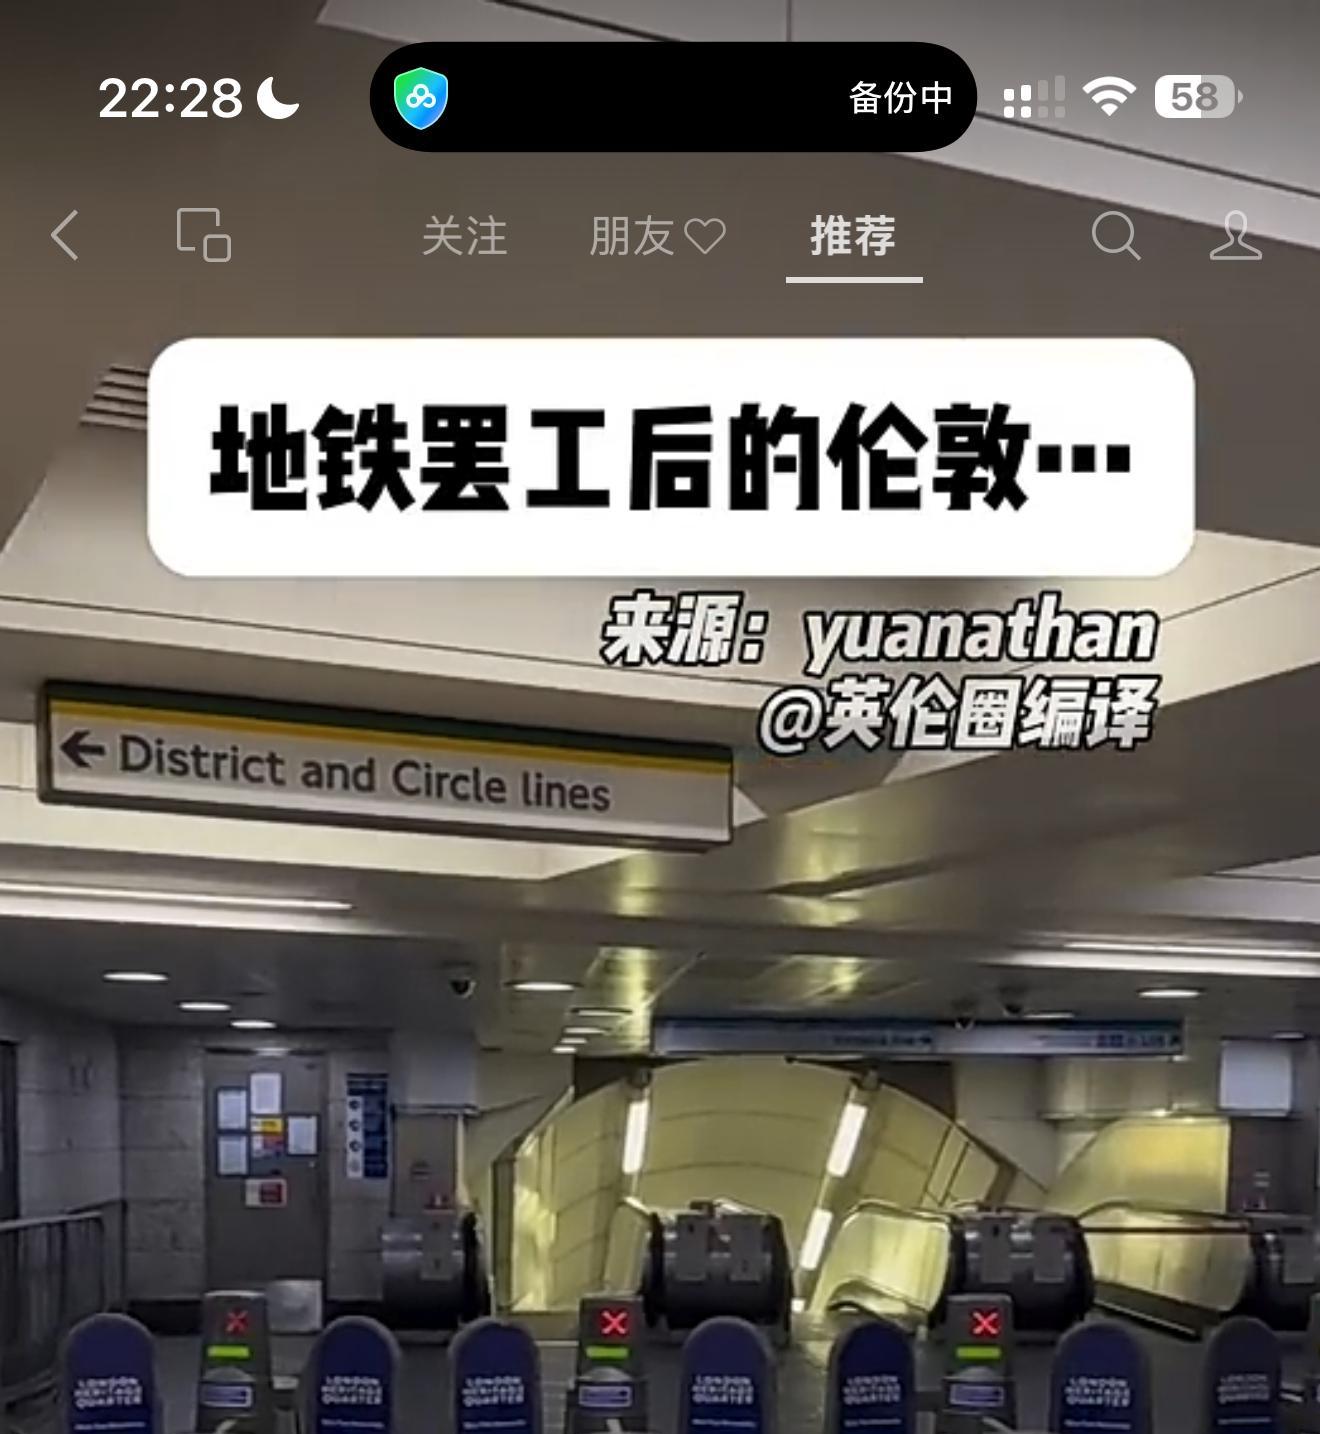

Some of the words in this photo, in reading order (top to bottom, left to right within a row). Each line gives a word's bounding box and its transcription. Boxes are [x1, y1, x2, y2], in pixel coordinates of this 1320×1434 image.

[119, 734, 287, 787] District
[301, 756, 376, 793] and
[391, 762, 508, 804] Circle
[521, 773, 611, 812] lines
